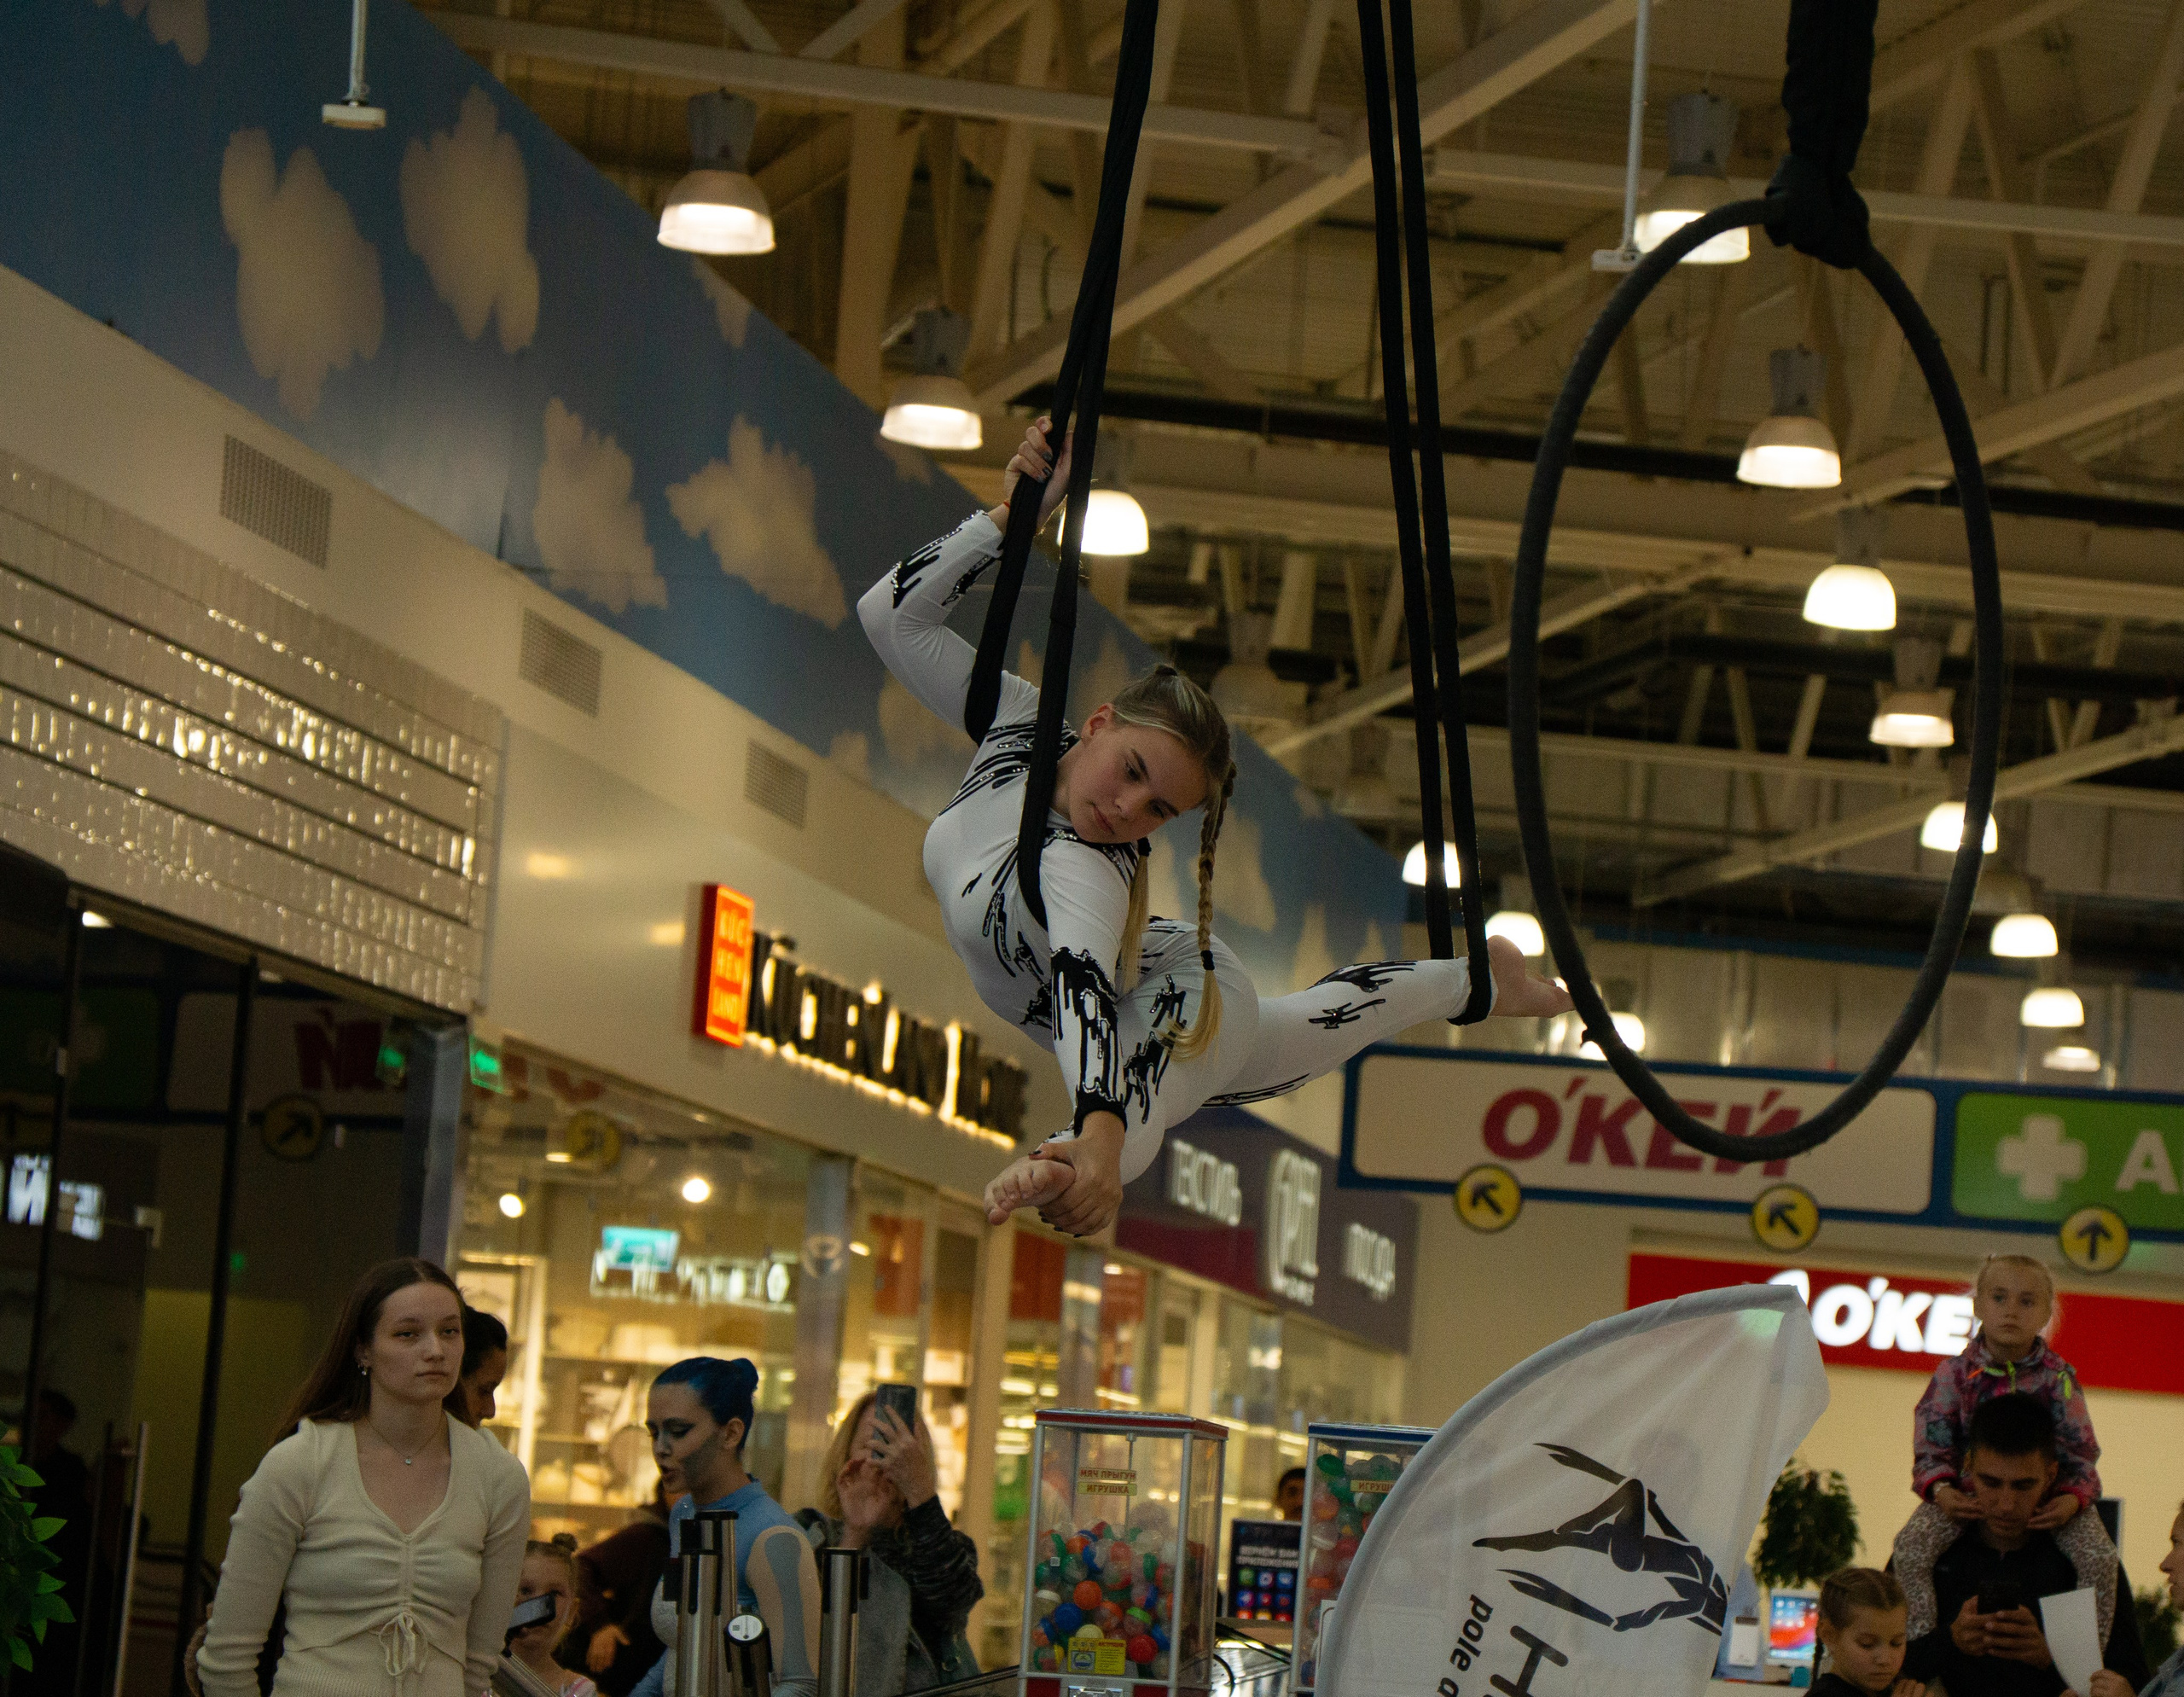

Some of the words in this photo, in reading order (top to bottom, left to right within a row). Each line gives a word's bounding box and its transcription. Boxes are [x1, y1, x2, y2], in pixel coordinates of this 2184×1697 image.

[2115, 1129, 2182, 1194] А
[1811, 1276, 1982, 1356] О'КЕ
[1086, 1485, 1129, 1493] ИГРУШКА
[1358, 1482, 1394, 1491] ИГРУШ
[1449, 1594, 1493, 1671] pole
[1480, 1625, 1569, 1697] H
[1437, 1677, 1459, 1697] a
